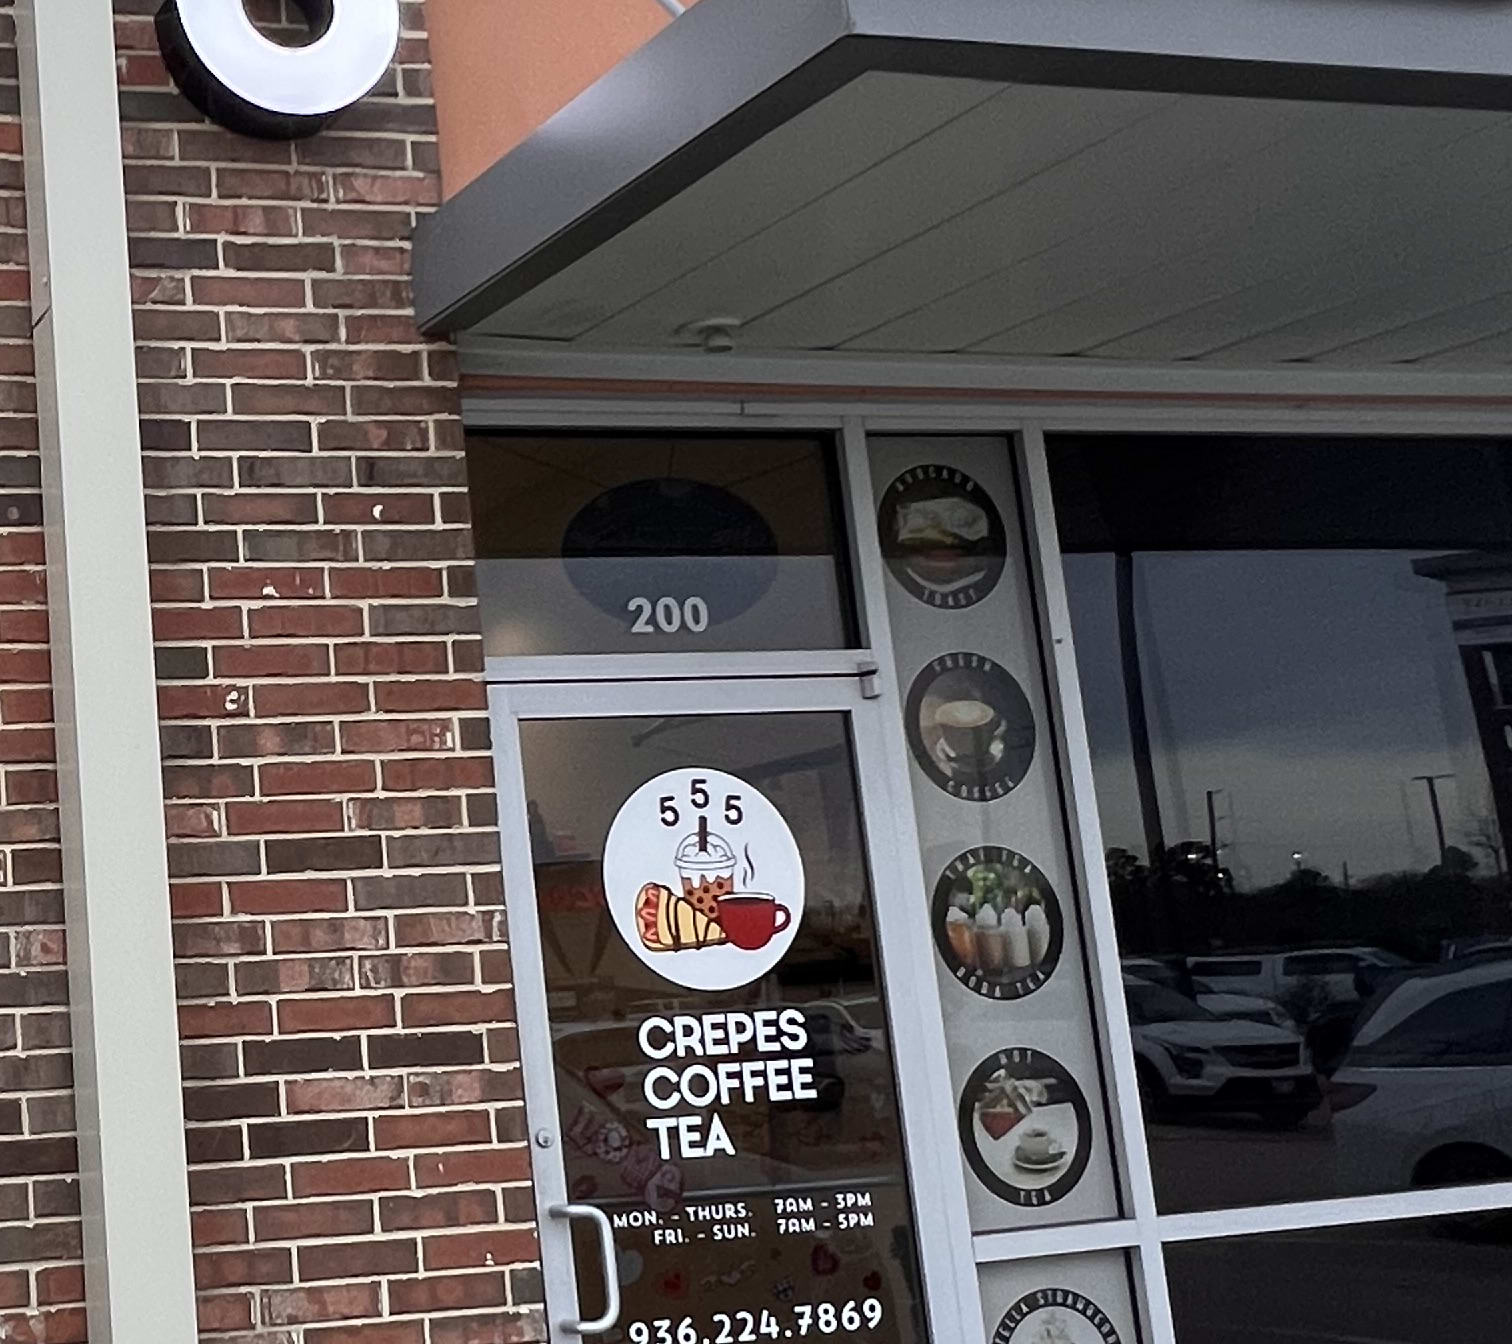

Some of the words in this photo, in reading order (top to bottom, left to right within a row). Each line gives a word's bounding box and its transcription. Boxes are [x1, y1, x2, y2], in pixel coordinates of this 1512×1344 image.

[627, 596, 709, 634] 200
[659, 795, 680, 827] 5
[691, 778, 710, 809] 5
[724, 795, 744, 825] 5
[956, 966, 1001, 997] BOBA
[1016, 969, 1046, 995] TEA
[638, 1008, 808, 1059] CREPES
[643, 1058, 817, 1110] COFFEE
[647, 1113, 736, 1160] TEA
[613, 1210, 663, 1228] MON.
[685, 1202, 754, 1222] THURS.
[774, 1197, 814, 1214] 7AM
[835, 1192, 872, 1209] 3PM
[1019, 1189, 1052, 1205] TEA
[654, 1229, 689, 1245] FRI.
[713, 1223, 756, 1240] SUN.
[777, 1217, 816, 1234] 7AM
[838, 1212, 874, 1229] 5PM
